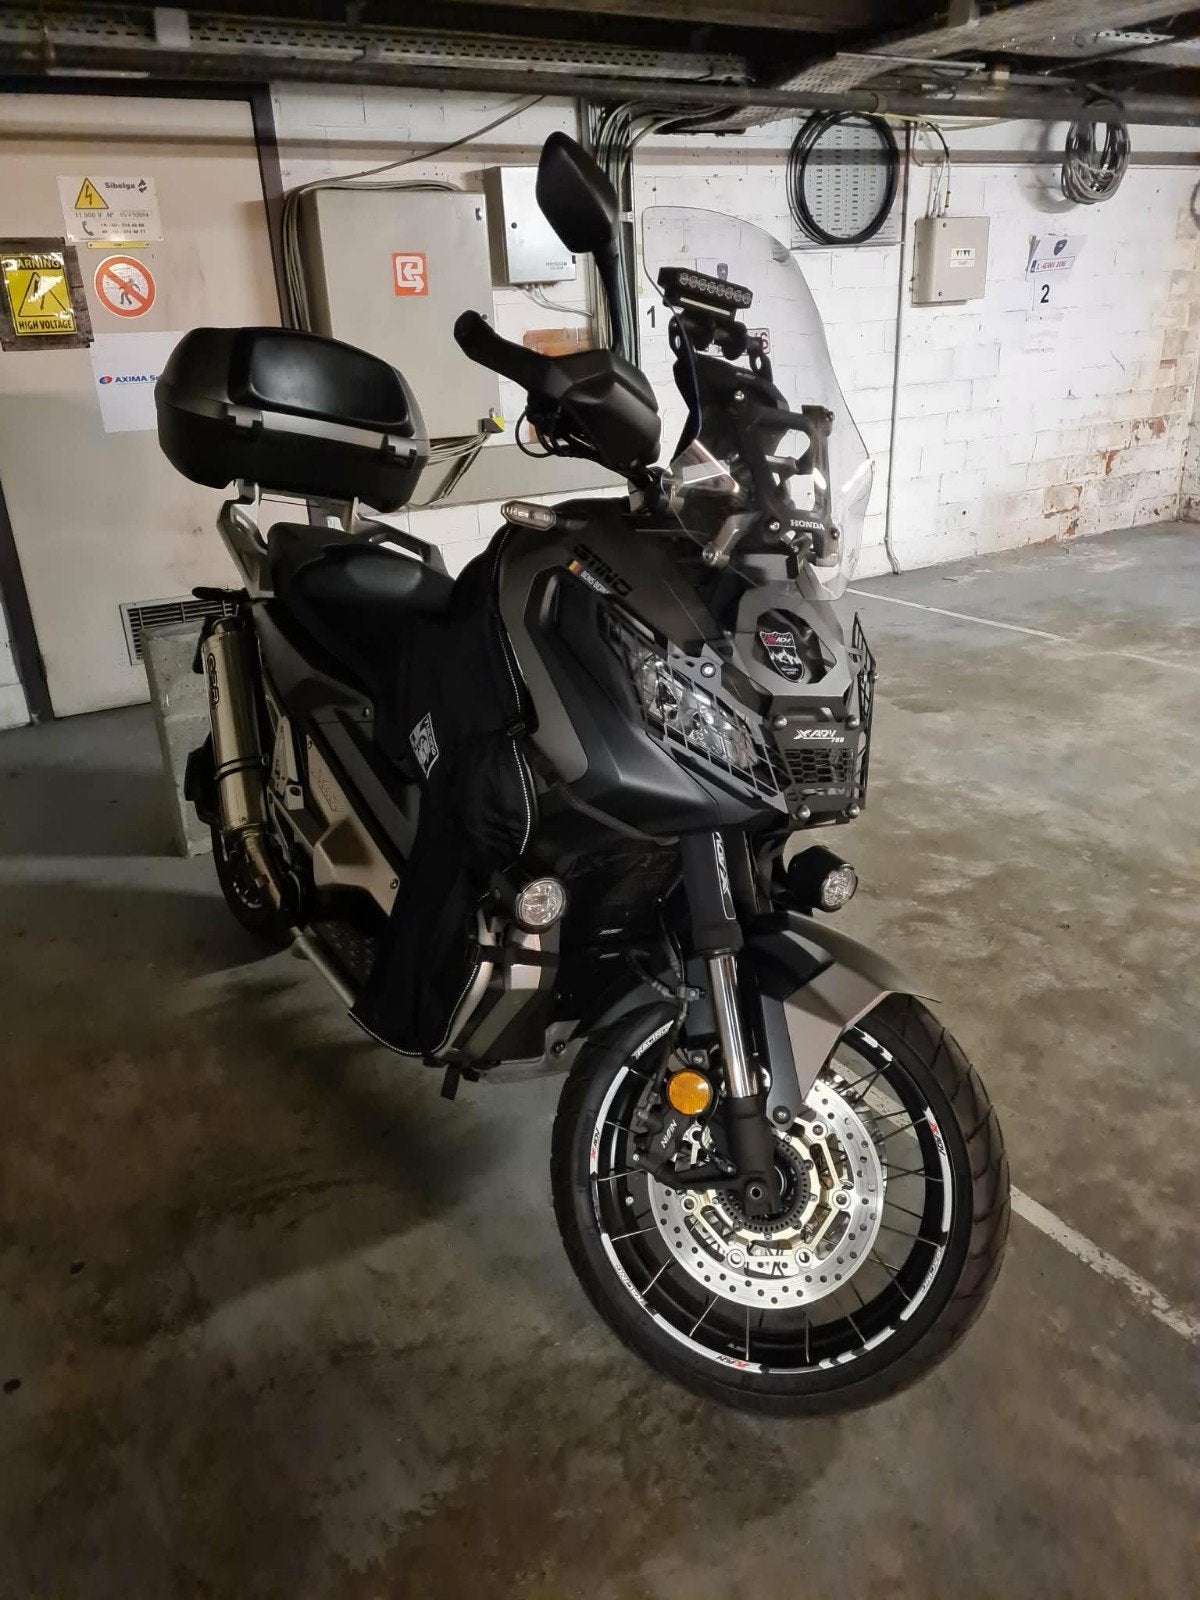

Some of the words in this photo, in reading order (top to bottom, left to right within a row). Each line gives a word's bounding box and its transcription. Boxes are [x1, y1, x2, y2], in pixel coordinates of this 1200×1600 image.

[104, 182, 136, 190] Sibelga
[6, 257, 61, 270] ARNING
[1040, 284, 1050, 303] 2
[646, 305, 656, 328] 1
[19, 320, 39, 330] HIGH
[40, 320, 73, 330] VOLTAGE
[115, 375, 148, 383] AXIMA
[790, 519, 826, 531] HONDA
[635, 1024, 669, 1057] RACING
